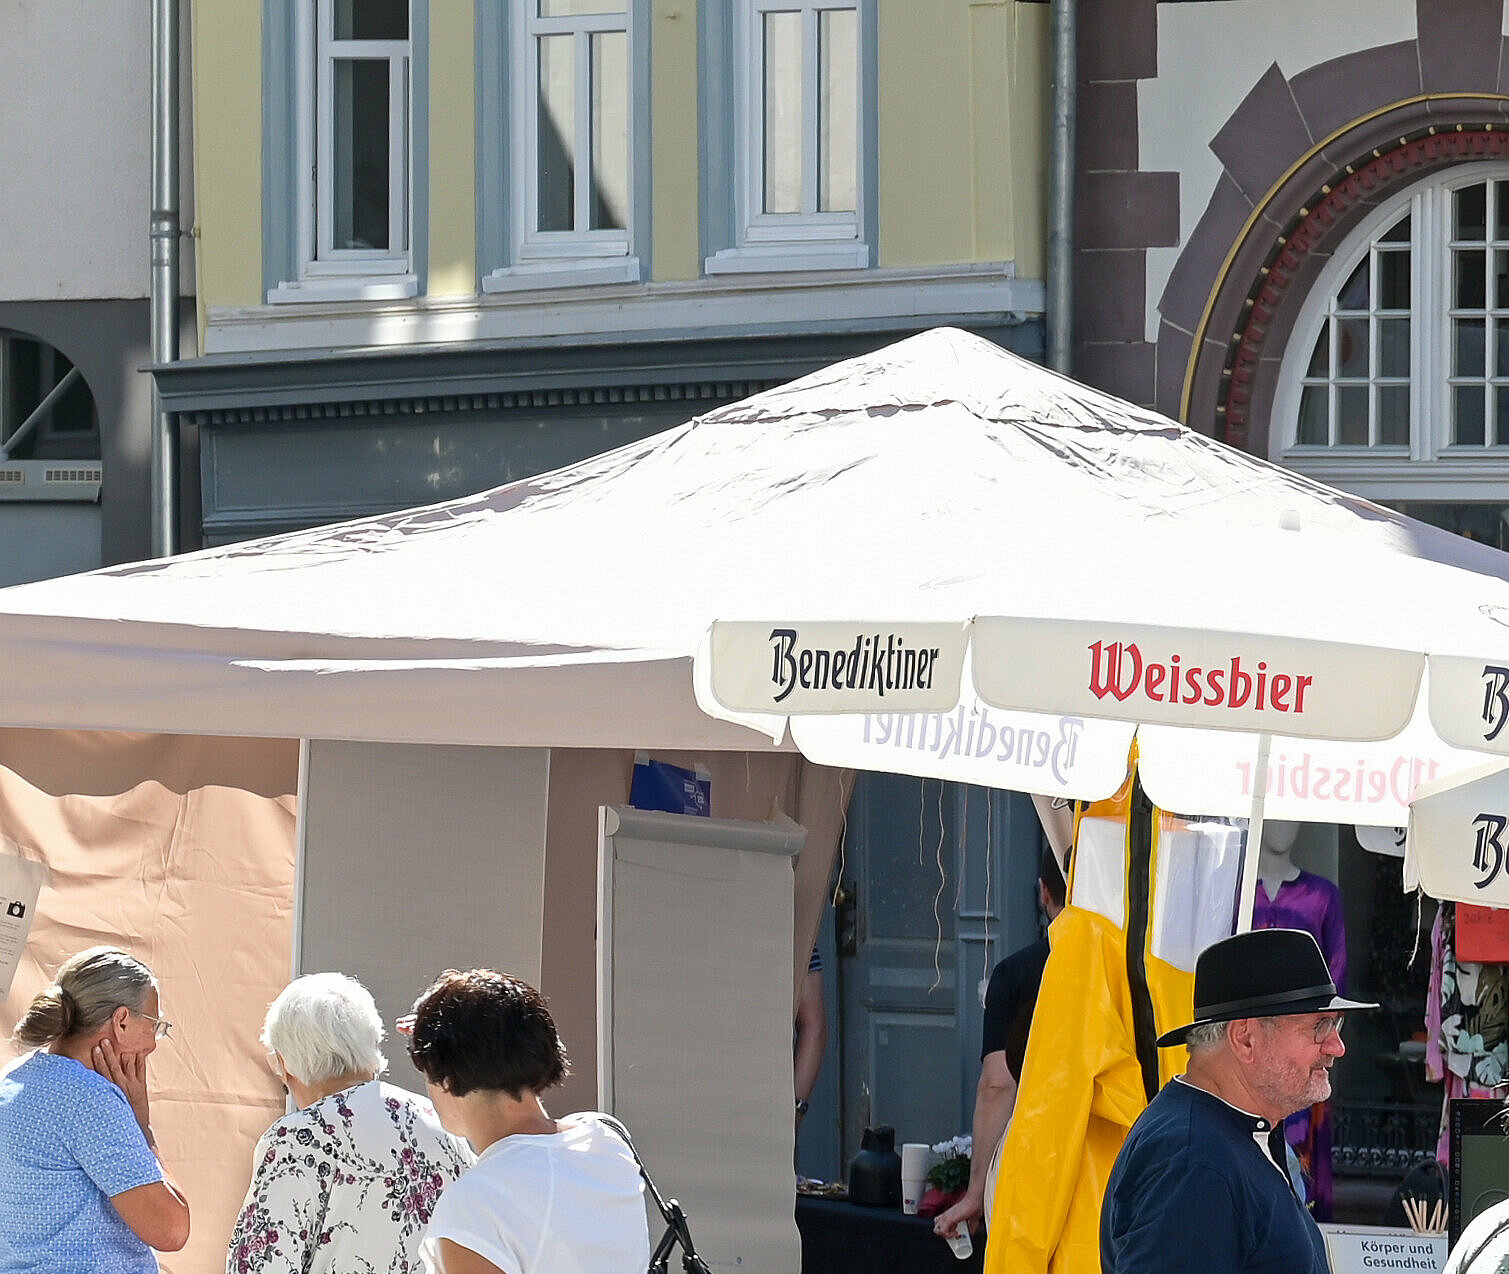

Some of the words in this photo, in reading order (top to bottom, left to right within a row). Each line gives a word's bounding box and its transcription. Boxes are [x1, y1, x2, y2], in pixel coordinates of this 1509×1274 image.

[769, 628, 939, 703] Benediktiner
[1088, 640, 1314, 714] Weissbier
[1361, 1240, 1405, 1255] Körper
[1408, 1243, 1433, 1255] und
[1363, 1256, 1438, 1270] Gesundheit
